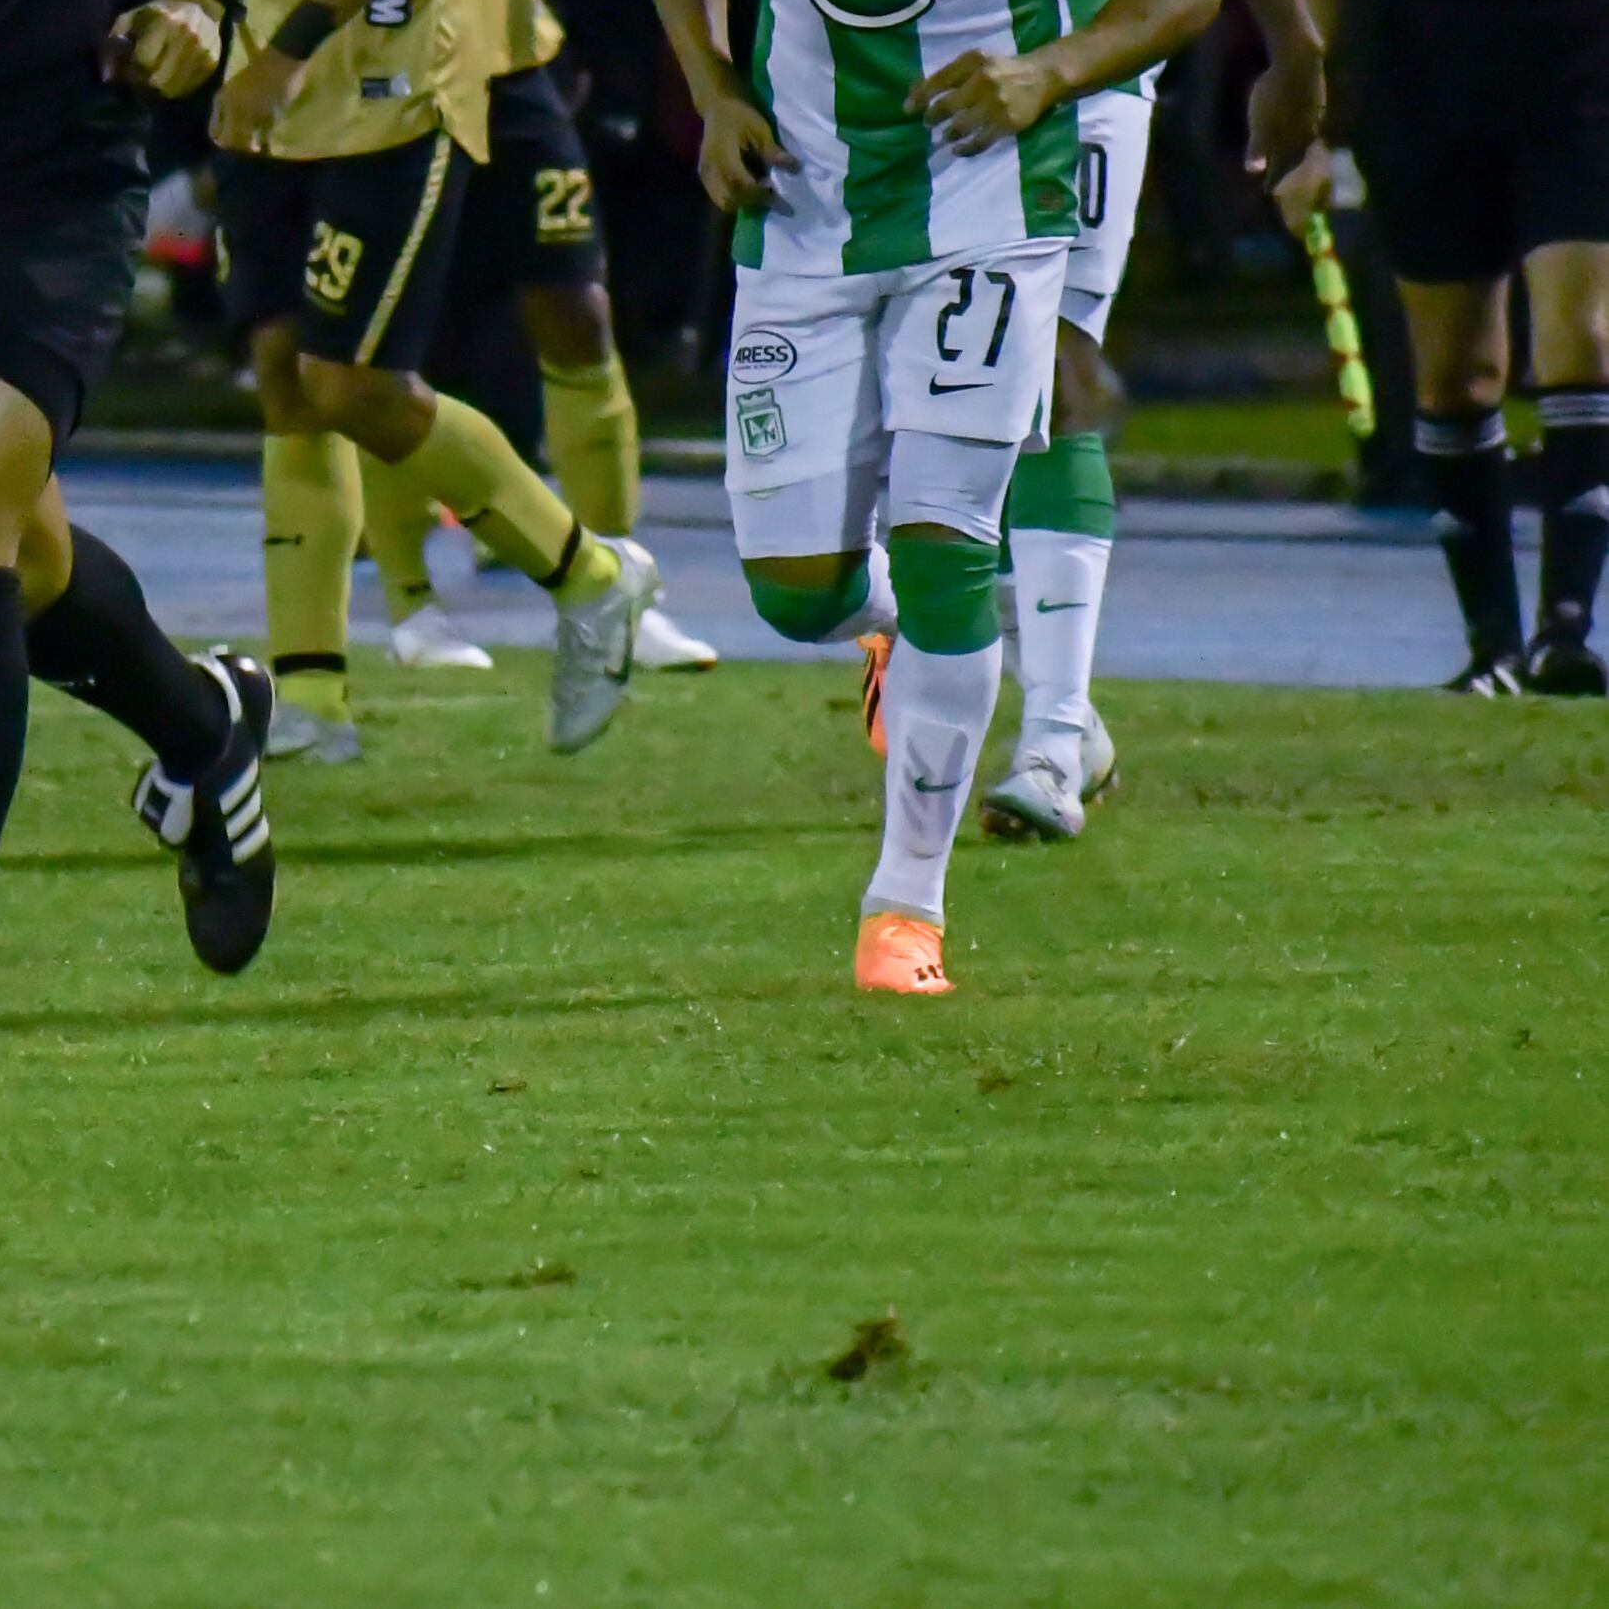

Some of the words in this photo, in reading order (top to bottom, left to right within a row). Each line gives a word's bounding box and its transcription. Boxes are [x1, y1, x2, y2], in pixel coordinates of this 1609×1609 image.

[535, 169, 591, 230] 22
[305, 220, 364, 300] 29
[937, 268, 1017, 368] 27
